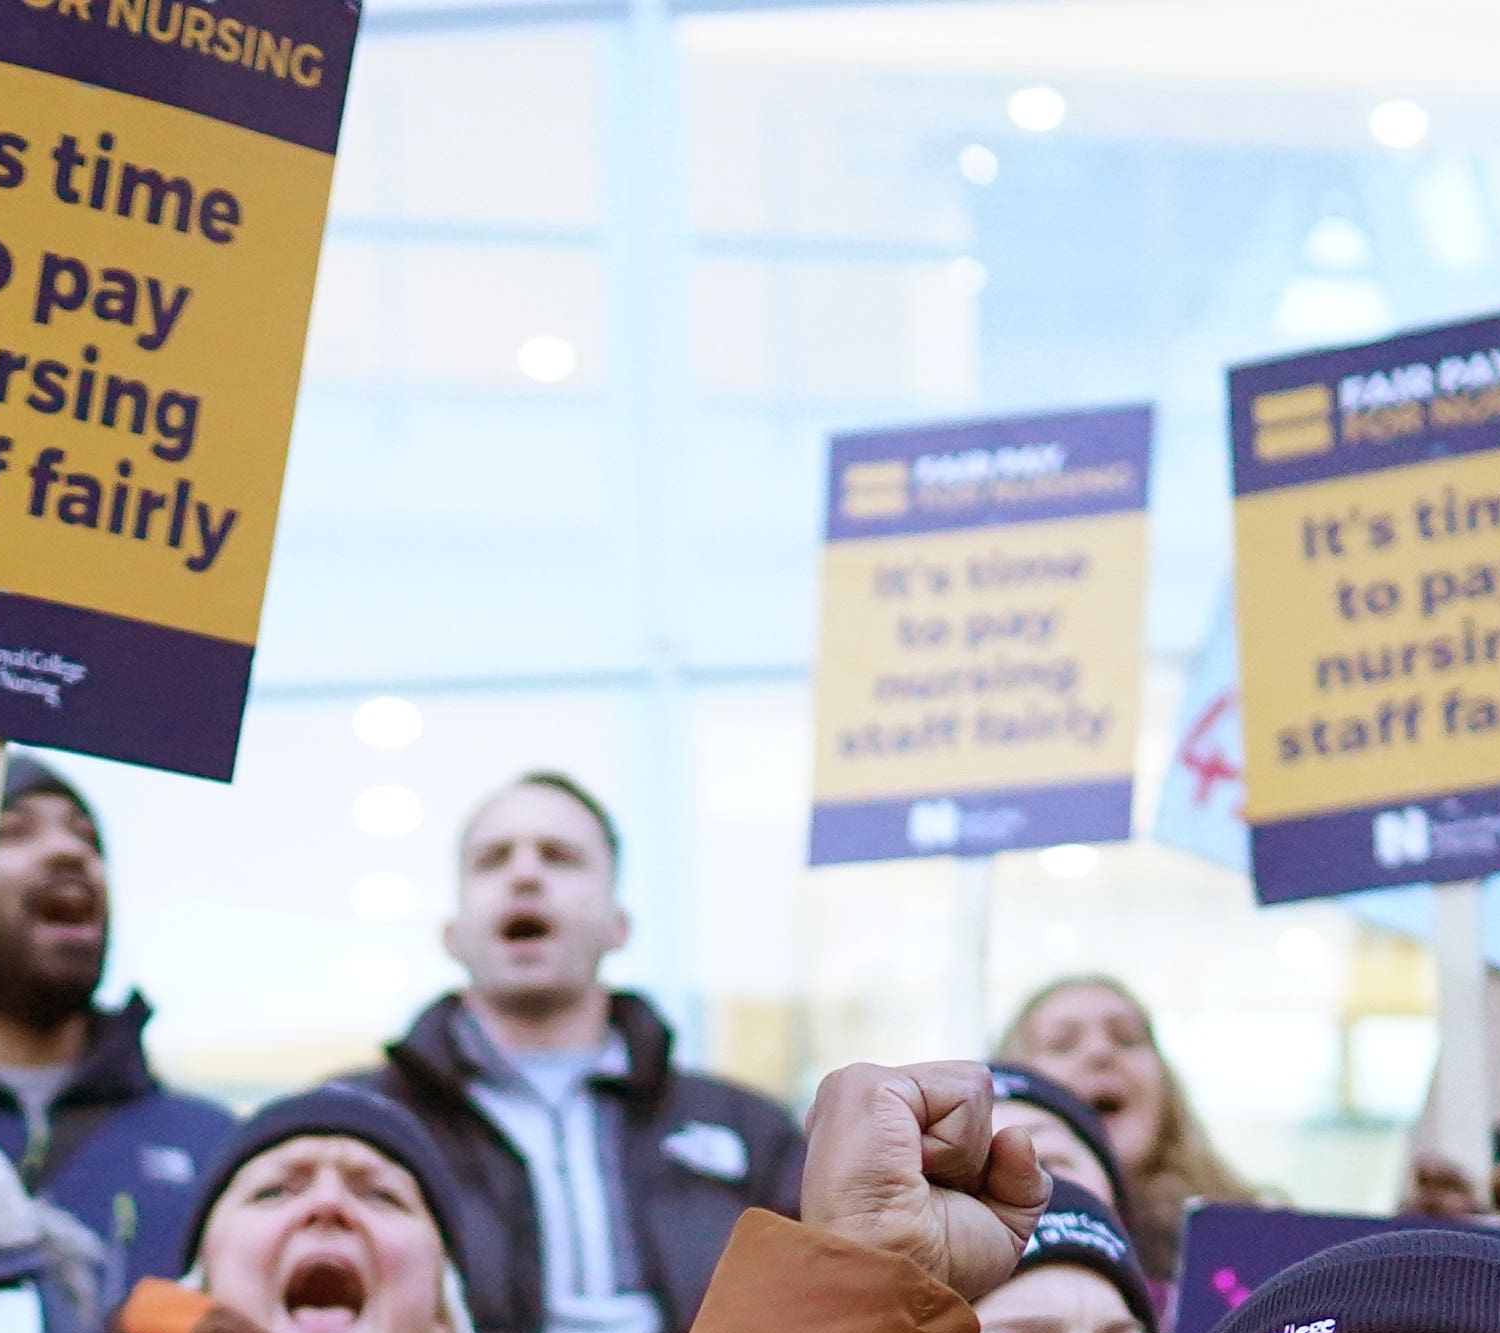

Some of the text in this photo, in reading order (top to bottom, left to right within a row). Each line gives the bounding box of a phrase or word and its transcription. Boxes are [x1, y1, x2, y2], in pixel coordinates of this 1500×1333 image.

[106, 0, 324, 87] NURSING
[52, 131, 241, 244] time
[33, 250, 192, 352] pay
[28, 447, 240, 572] fairly
[1336, 580, 1399, 620] to
[1277, 698, 1422, 762] staff
